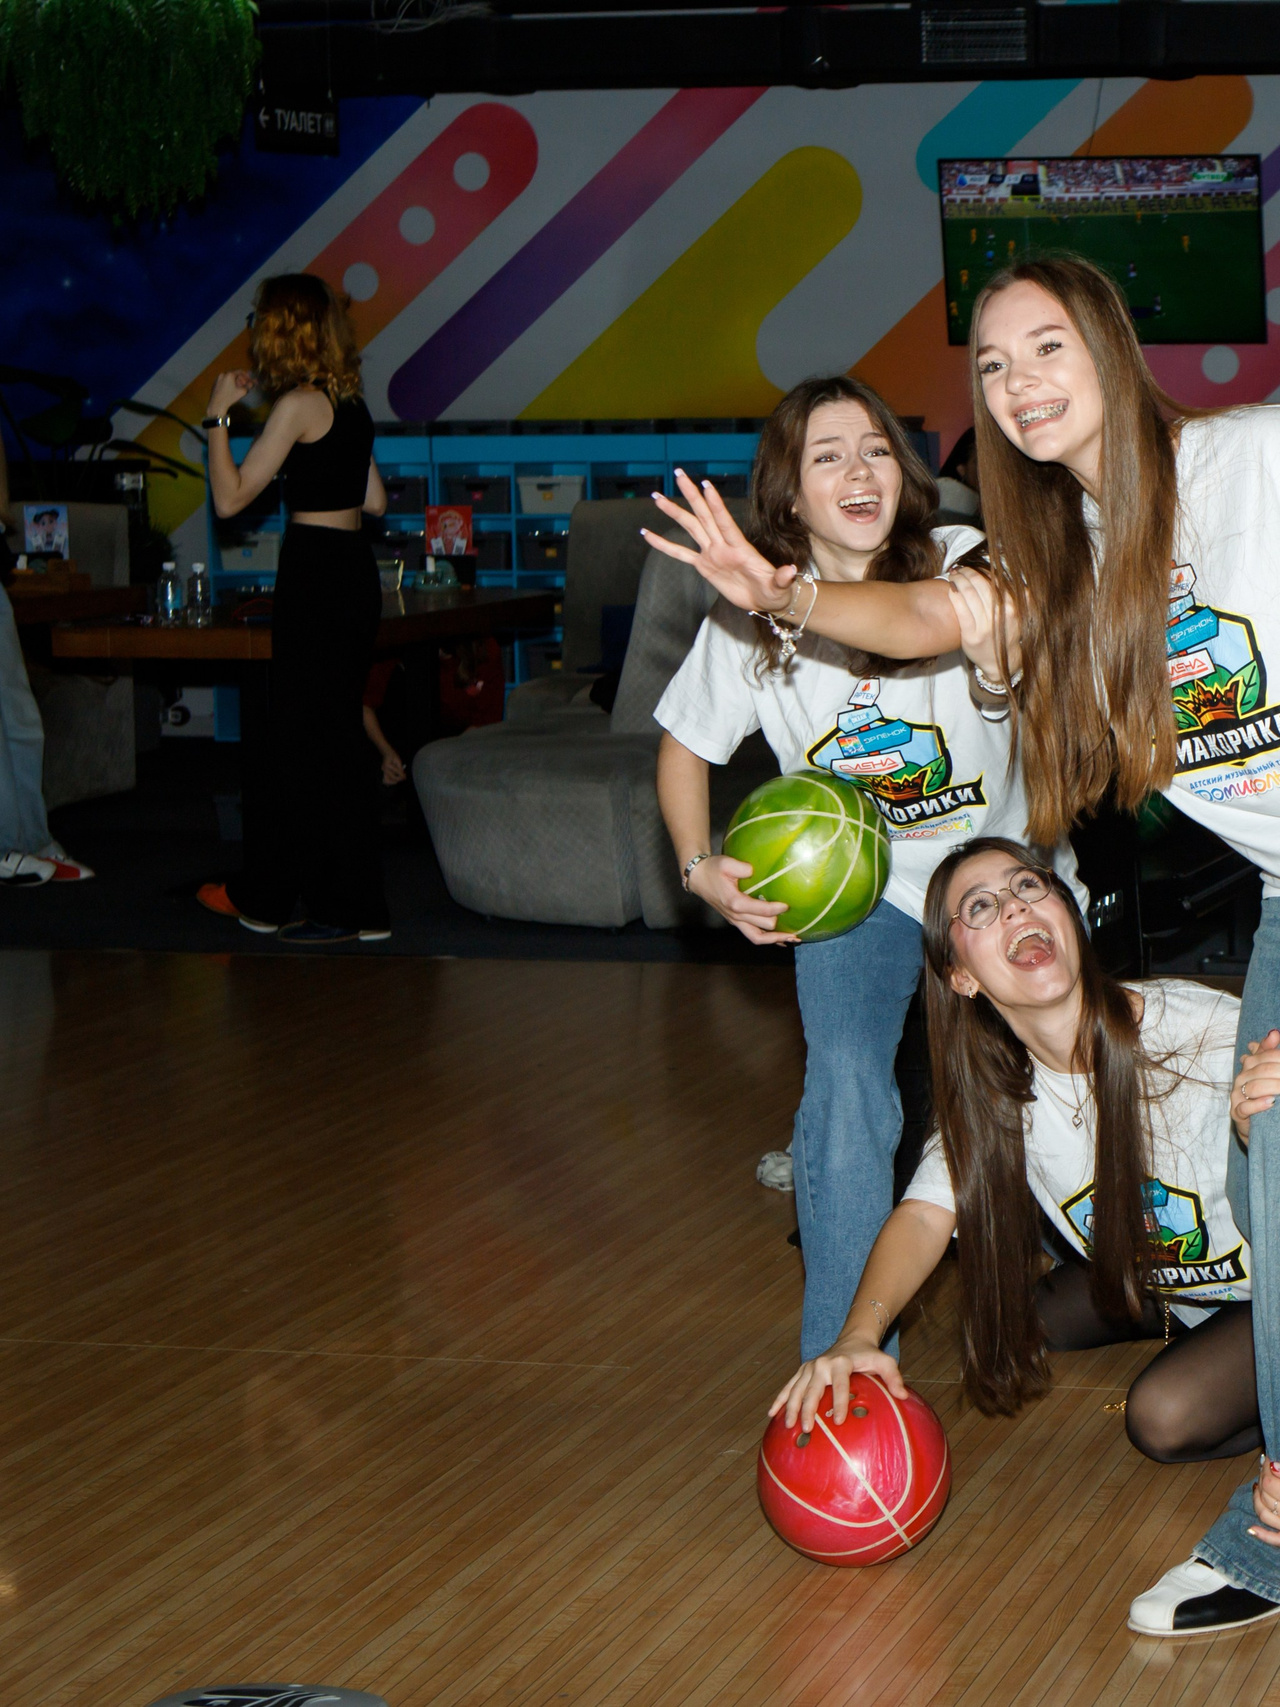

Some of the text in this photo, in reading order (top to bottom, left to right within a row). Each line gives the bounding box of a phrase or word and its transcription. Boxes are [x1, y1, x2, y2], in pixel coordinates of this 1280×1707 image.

[274, 108, 322, 134] ТУАЛЕТ
[1168, 657, 1206, 676] МЕНА
[853, 691, 877, 701] АРТЕК
[1190, 774, 1223, 790] ДЕТСКИЙ
[866, 786, 977, 824] ЖОРИКИ
[1208, 1286, 1233, 1297] ТЕАТР
